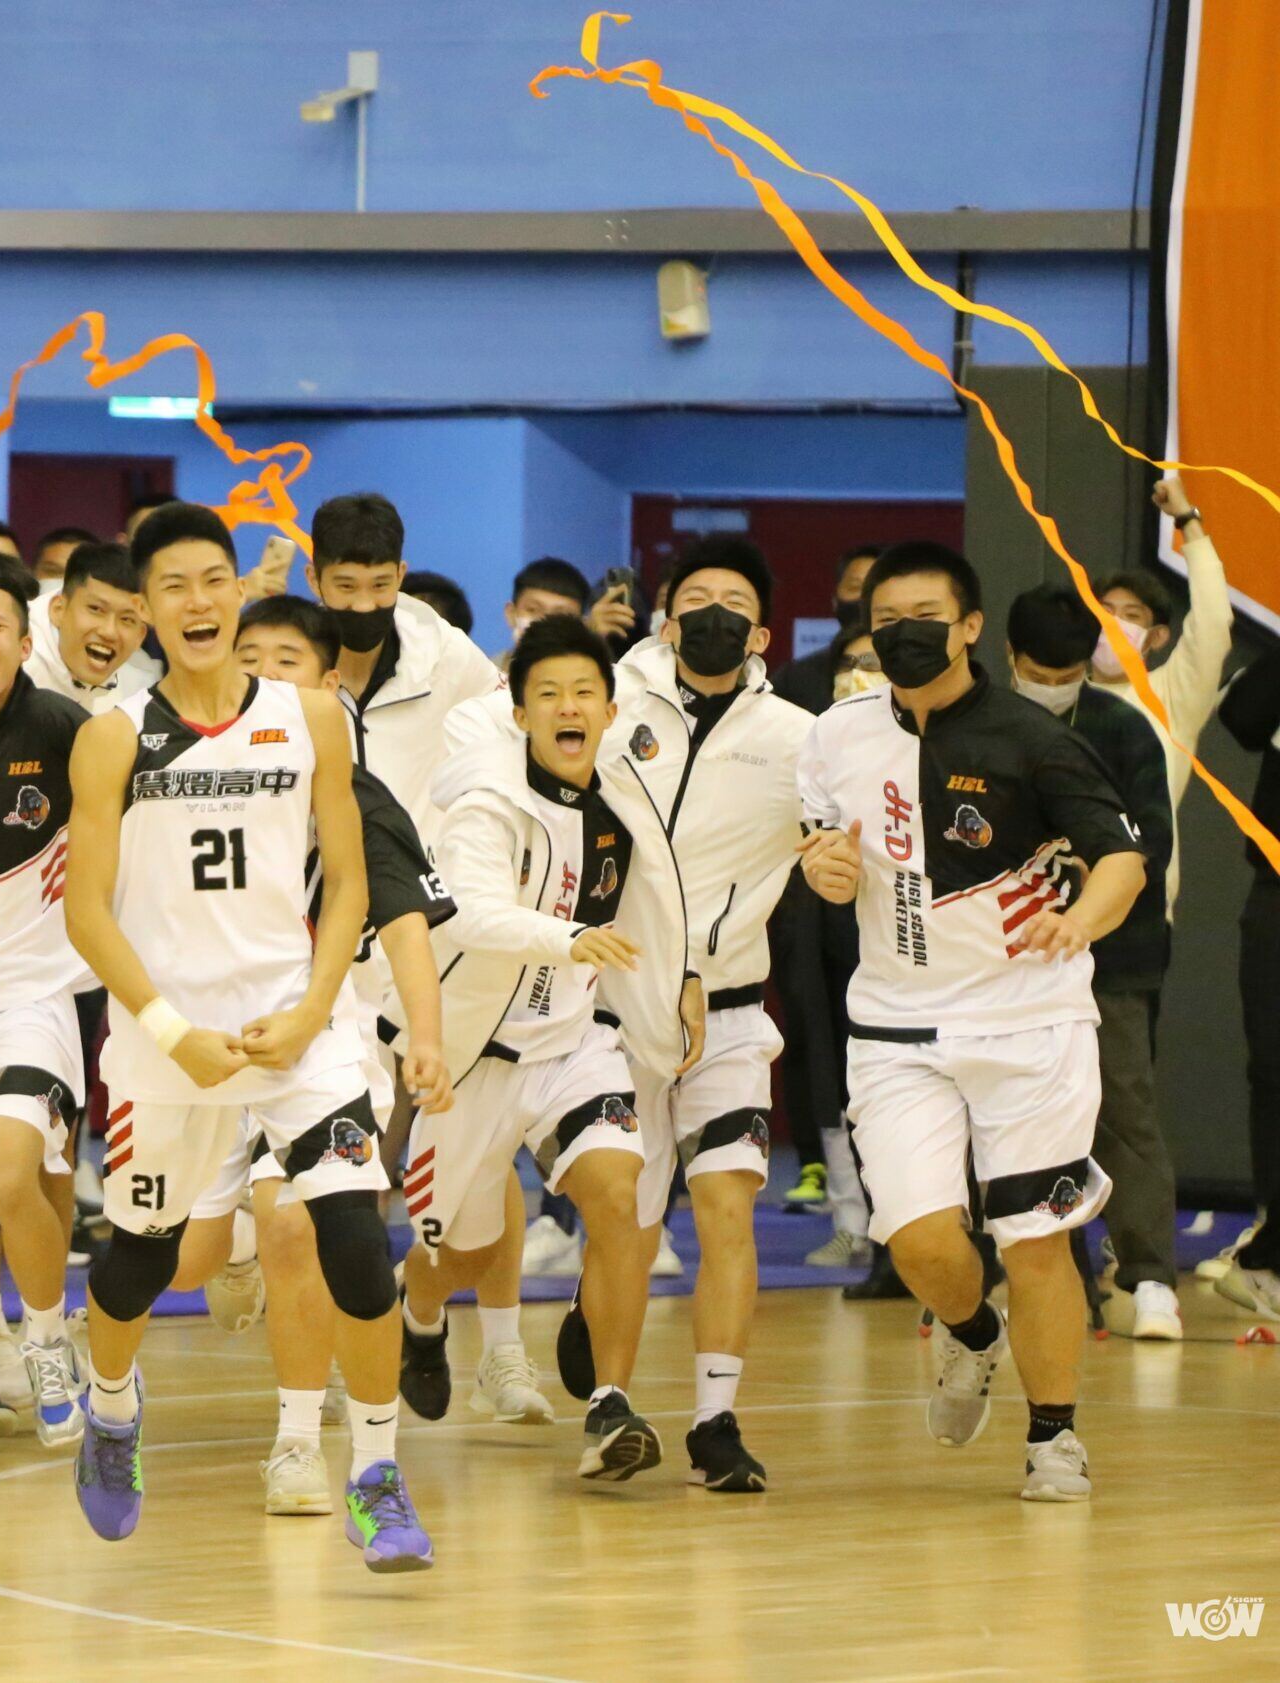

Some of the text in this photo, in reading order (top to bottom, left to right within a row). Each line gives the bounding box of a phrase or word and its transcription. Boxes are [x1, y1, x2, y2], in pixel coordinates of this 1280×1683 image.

[250, 728, 289, 745] HBL
[7, 760, 43, 776] HBL
[133, 765, 301, 802] 慧燈高中
[946, 773, 988, 794] HBL
[186, 802, 247, 813] YILAN
[190, 827, 248, 892] 21
[418, 871, 450, 901] 13
[894, 870, 909, 956] BASKETBALL
[909, 871, 927, 967] HIGH SCHOOL
[131, 1173, 165, 1210] 21
[422, 1217, 442, 1248] 2
